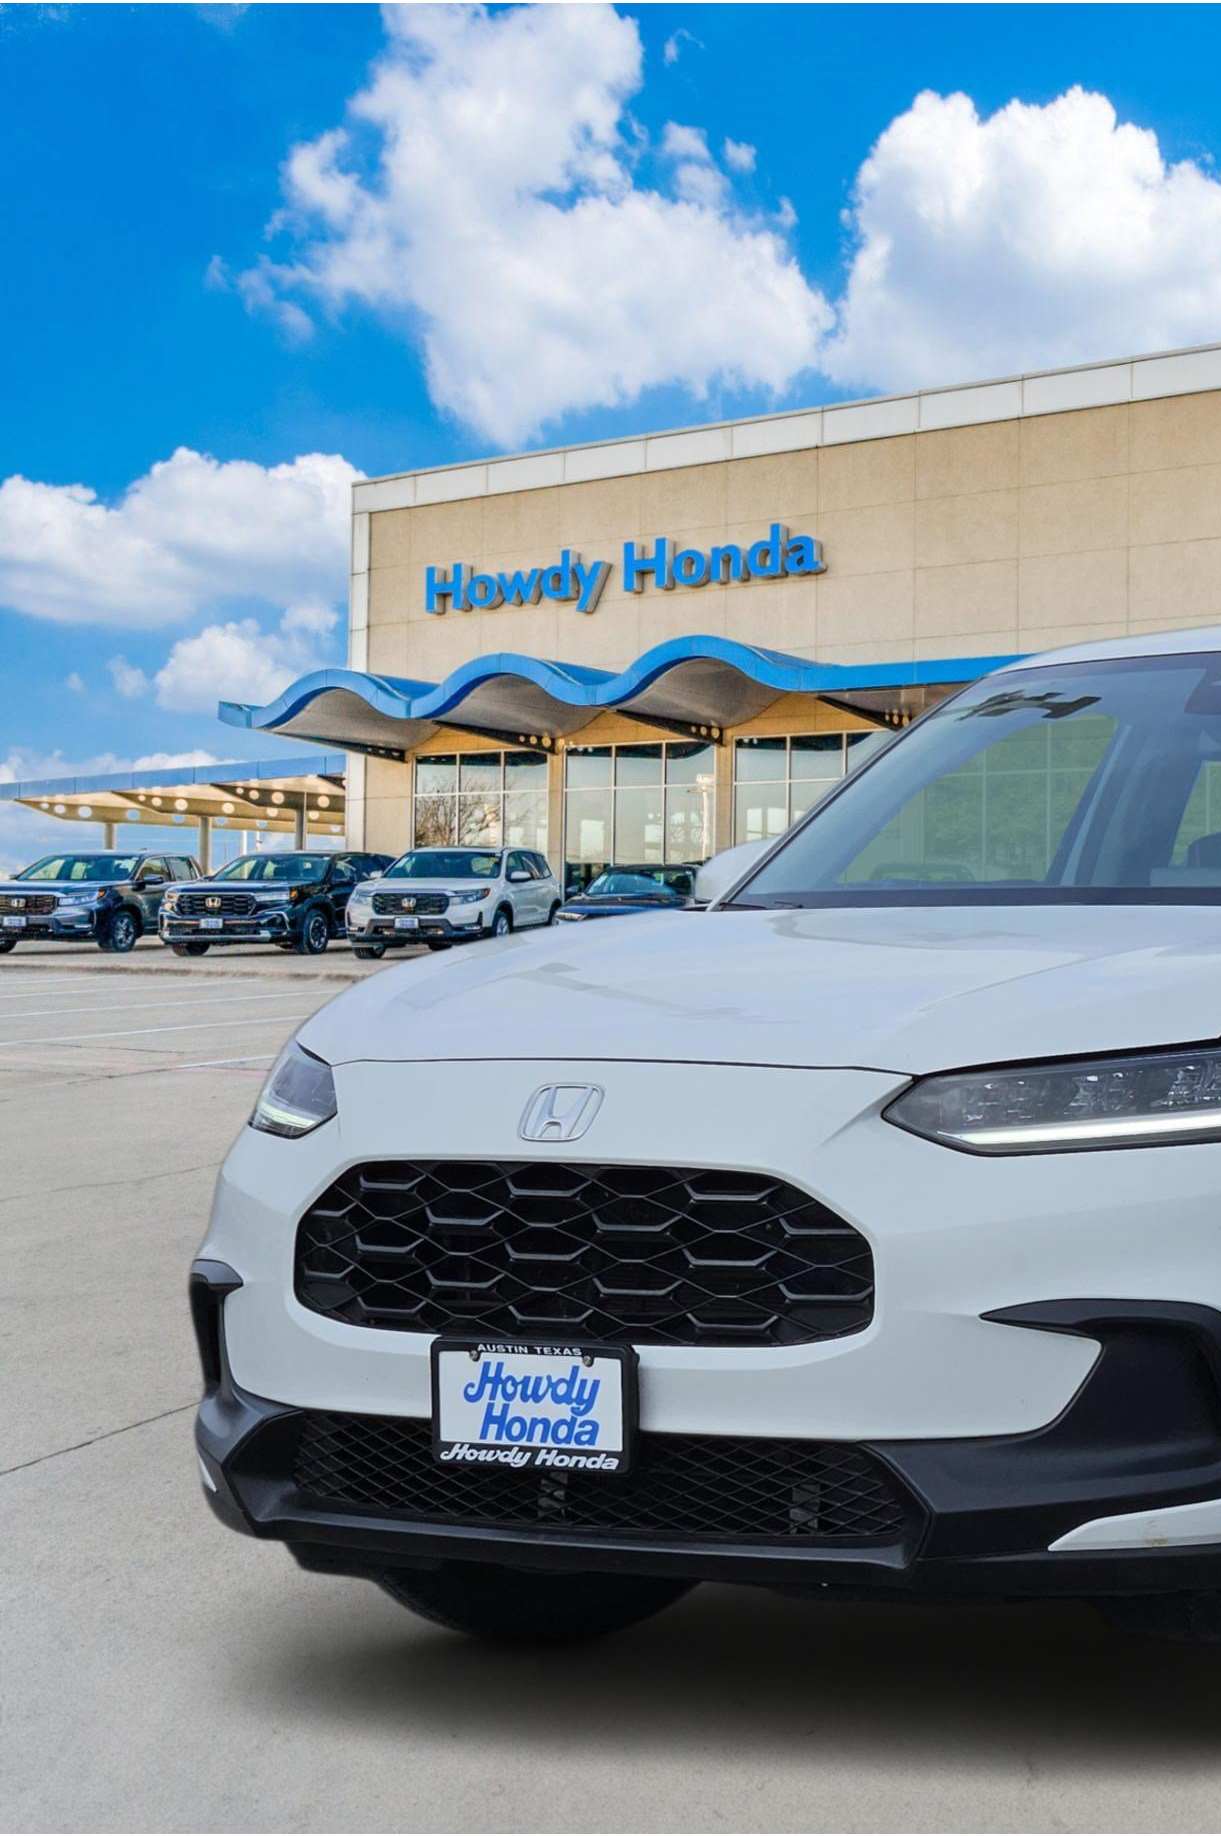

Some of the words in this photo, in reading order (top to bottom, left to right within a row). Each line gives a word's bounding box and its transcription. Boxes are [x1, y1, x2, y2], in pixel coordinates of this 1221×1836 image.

[425, 549, 612, 614] Howdy
[623, 523, 826, 593] Honda
[477, 1343, 529, 1354] AUSTIN
[534, 1346, 582, 1356] TEXAS
[464, 1361, 600, 1416] Howdy
[479, 1402, 600, 1446] Honda
[440, 1443, 531, 1468] Howdy
[535, 1449, 620, 1470] Honda
